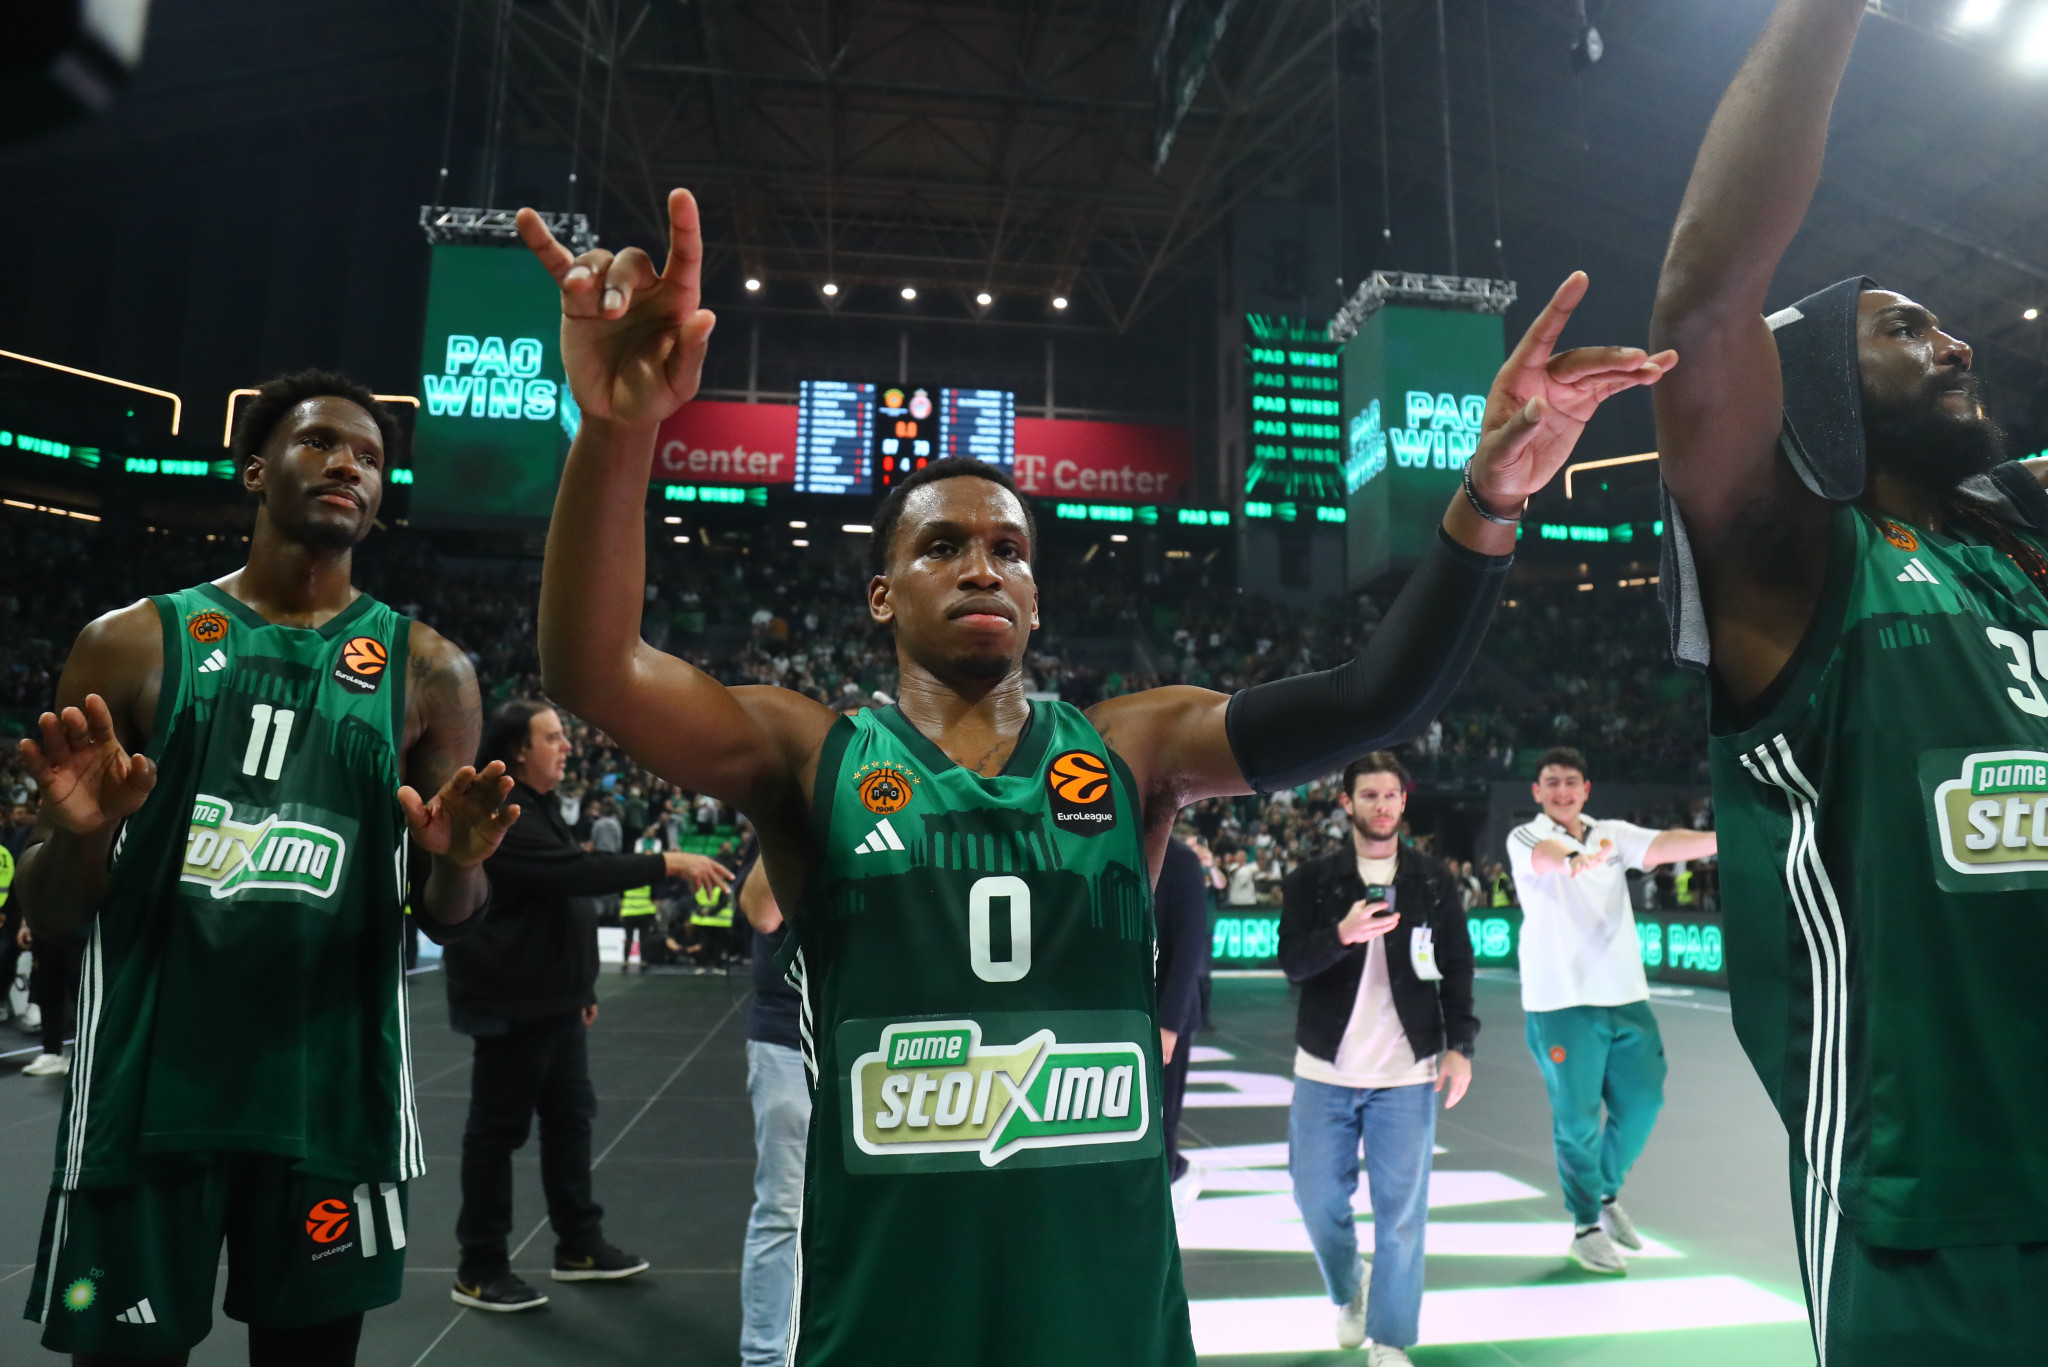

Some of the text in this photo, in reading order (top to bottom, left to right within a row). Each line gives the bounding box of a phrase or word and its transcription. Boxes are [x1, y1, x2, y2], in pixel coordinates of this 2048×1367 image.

[445, 335, 543, 378] PAO
[423, 374, 557, 420] WINS
[661, 440, 784, 475] Center
[1389, 428, 1480, 470] WIN
[1053, 459, 1169, 493] Center
[335, 669, 376, 690] EuroLeague
[242, 703, 295, 781] 11
[1979, 763, 2047, 792] pame
[192, 804, 220, 823] me
[1057, 811, 1113, 823] EuroLeague
[969, 875, 1032, 983] 0
[1668, 923, 1722, 972] PAO
[893, 1035, 963, 1065] pame
[353, 1182, 406, 1258] 11
[312, 1241, 353, 1261] EuroLeague
[90, 1266, 105, 1279] bp
